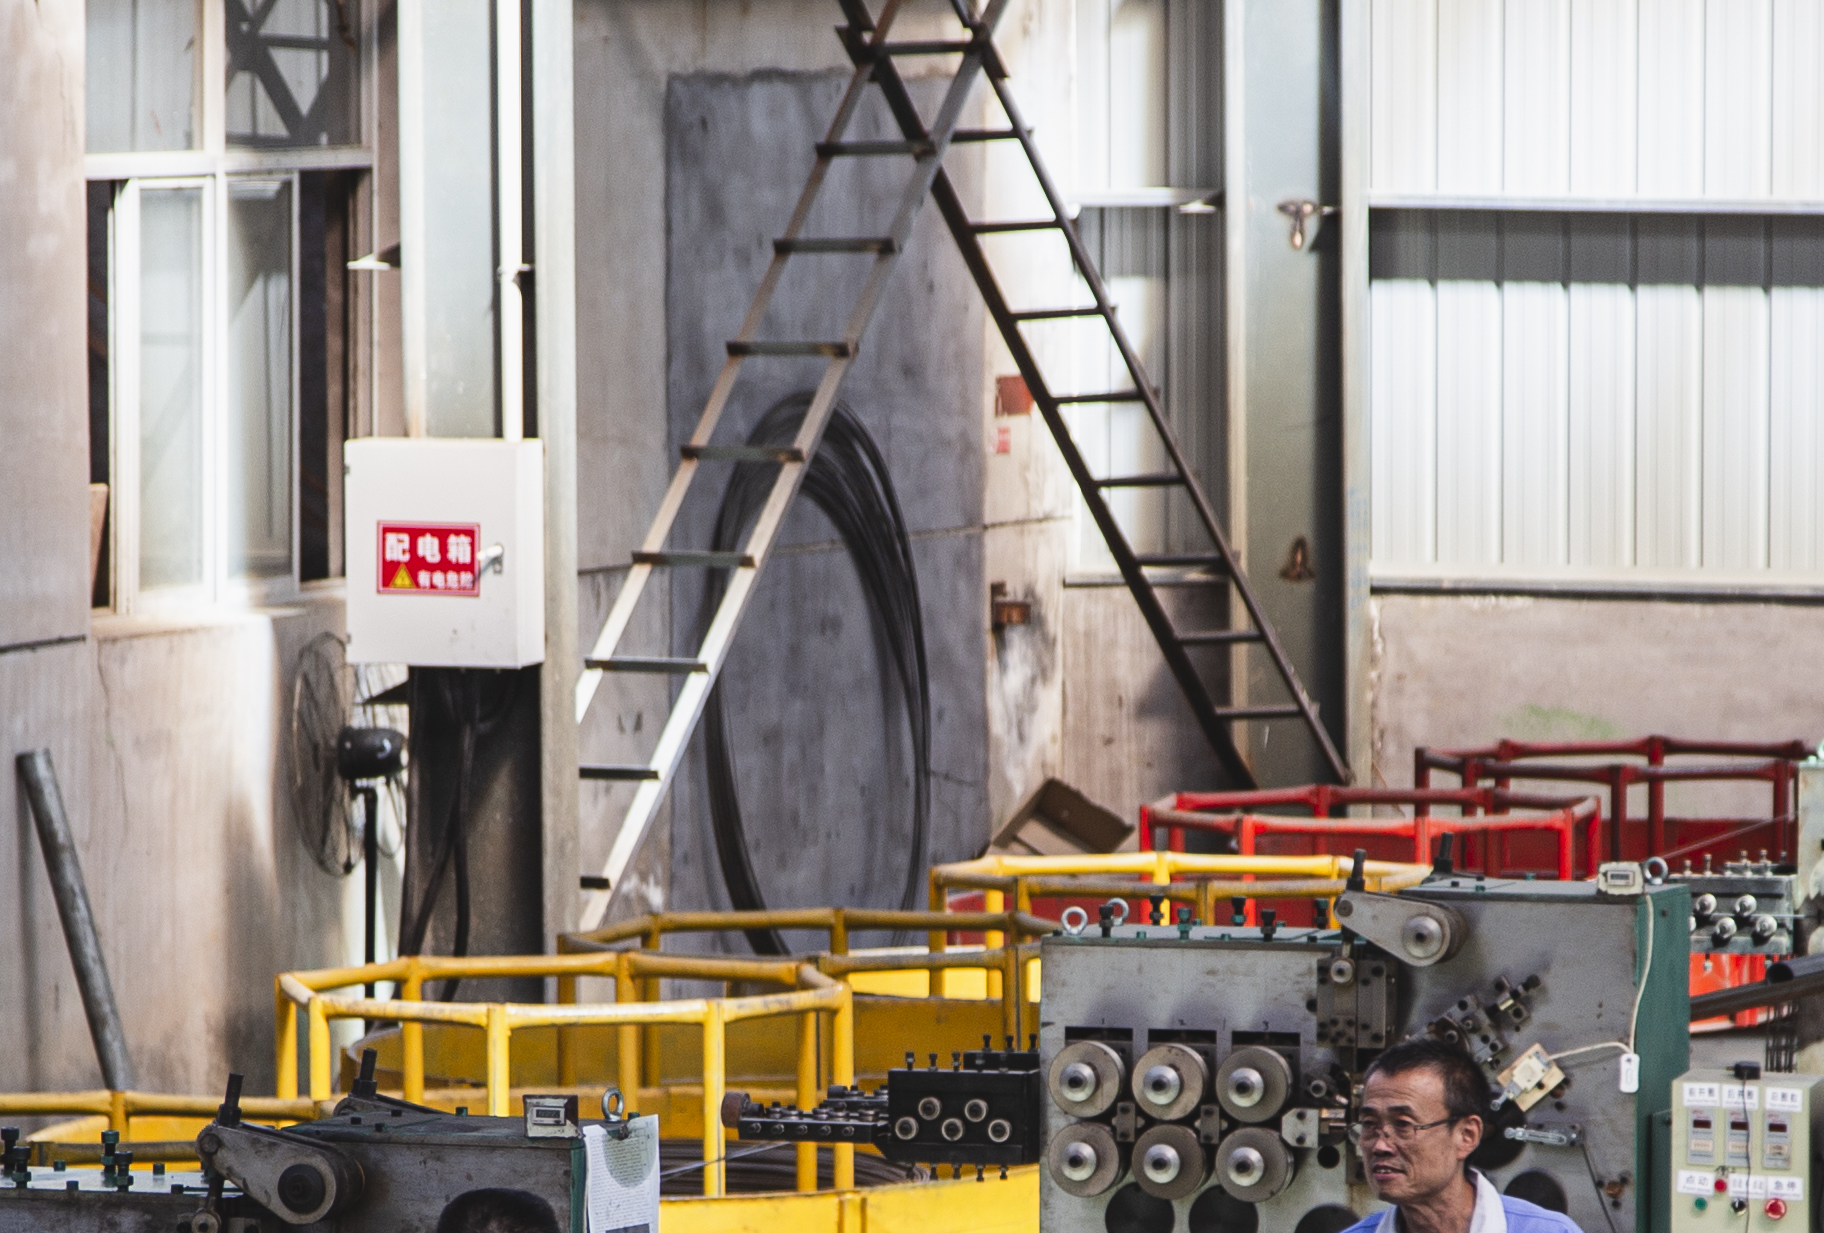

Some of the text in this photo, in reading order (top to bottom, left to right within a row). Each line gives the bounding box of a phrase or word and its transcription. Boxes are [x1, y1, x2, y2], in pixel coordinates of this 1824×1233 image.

[384, 532, 473, 565] 配电箱
[416, 569, 475, 590] 有电危险
